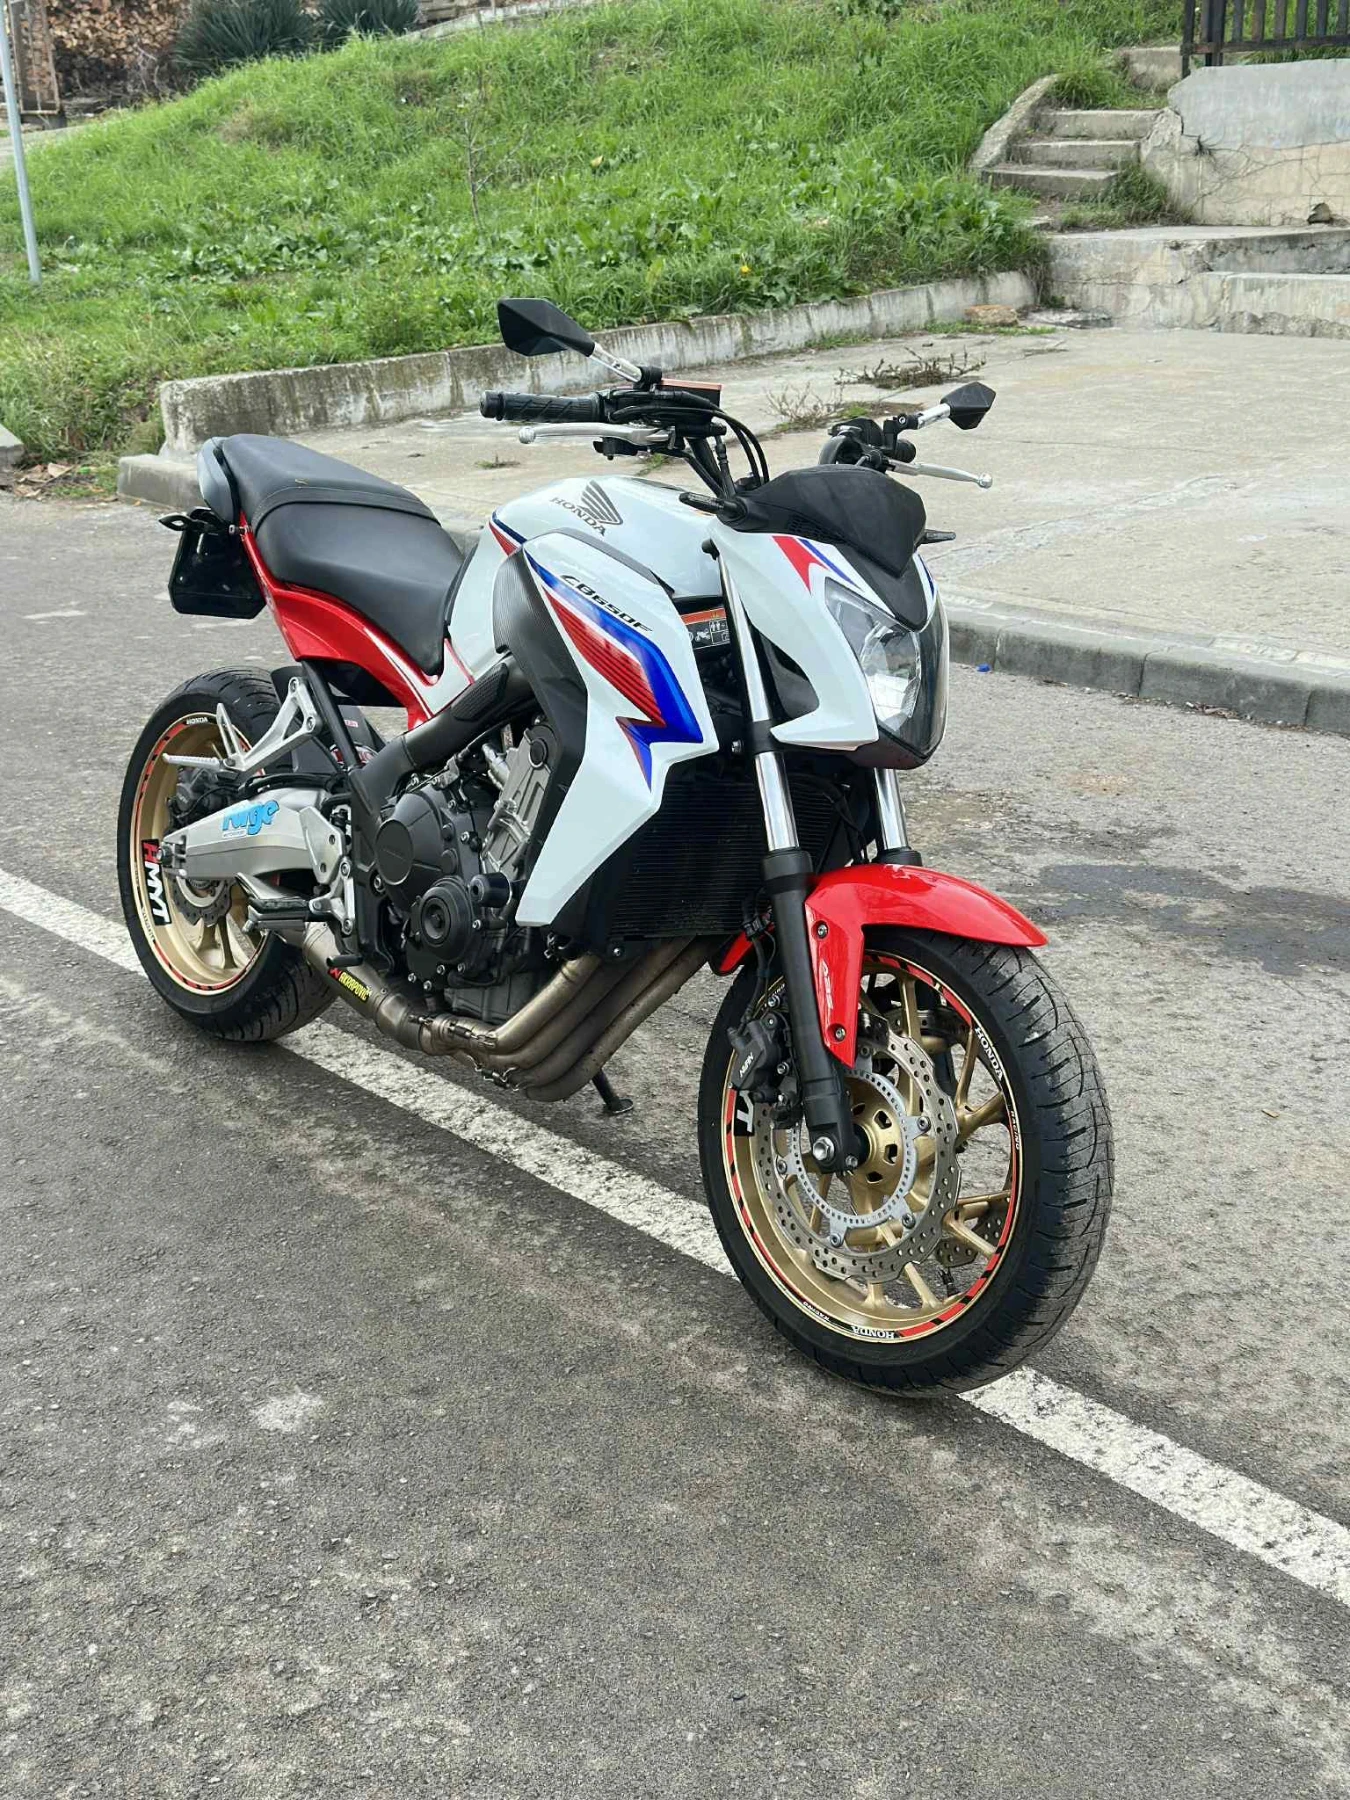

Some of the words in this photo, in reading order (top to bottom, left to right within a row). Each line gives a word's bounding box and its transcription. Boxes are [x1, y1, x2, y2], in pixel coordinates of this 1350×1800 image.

[551, 497, 607, 536] HONDA
[560, 574, 653, 632] CB650F
[975, 1027, 1003, 1081] HONDA
[851, 1325, 895, 1340] HONDA
